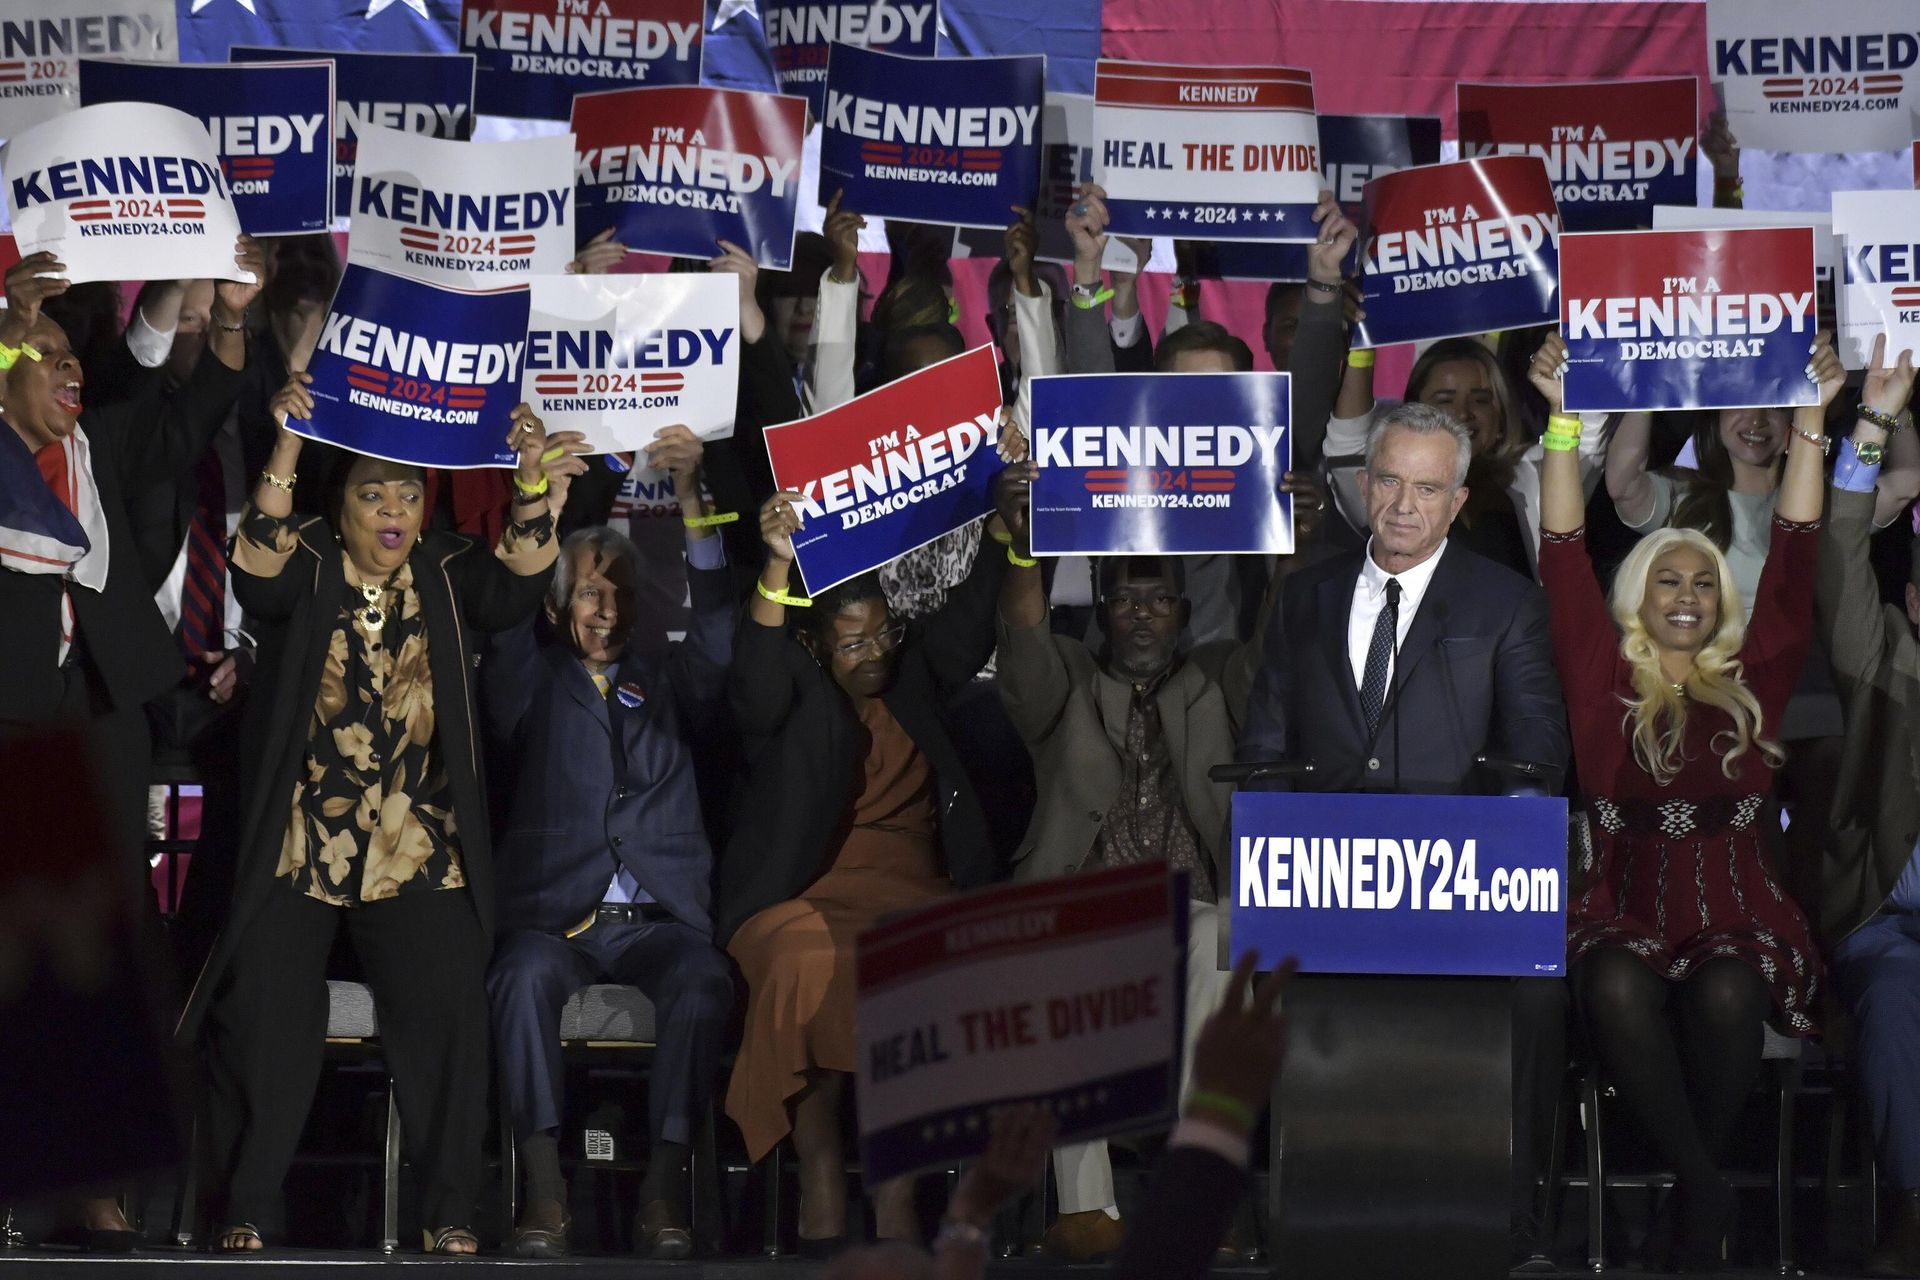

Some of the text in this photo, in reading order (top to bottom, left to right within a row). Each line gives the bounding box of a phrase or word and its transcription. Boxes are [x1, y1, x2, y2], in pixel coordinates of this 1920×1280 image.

[594, 0, 611, 16] A
[0, 14, 164, 58] NNEDY
[465, 8, 700, 61] KENNEDY
[511, 54, 649, 80] DEMOCRAT
[1716, 32, 1920, 75] KENNED
[31, 60, 79, 79] 202
[1179, 86, 1259, 103] KENNEDY
[1808, 78, 1860, 96] 2024
[826, 89, 1039, 147] KENNEDY
[1770, 98, 1899, 114] KENNEDY24.COM
[652, 127, 706, 145] I'M A
[1552, 125, 1607, 142] I'M A
[907, 147, 960, 167] 2024
[1103, 140, 1173, 170] HEAL
[1182, 143, 1234, 171] THE
[1243, 144, 1318, 172] DIVIDE
[1465, 136, 1694, 181] NNEDY
[12, 156, 226, 210] KENNEDY
[575, 145, 797, 197] KENNEDY
[864, 164, 998, 186] KENNEDY24.COM
[115, 199, 165, 218] 2024
[359, 177, 570, 232] KENNEDY
[606, 185, 743, 213] DEMOCRAT
[1194, 207, 1237, 224] 2024
[1424, 204, 1480, 226] I'M A
[80, 222, 205, 237] KENNEDY24.COM
[444, 235, 496, 255] 2024
[405, 250, 531, 272] KENNEDY24.COM
[1842, 244, 1920, 285] KE
[1393, 258, 1529, 294] DEMOCRAT
[1663, 277, 1721, 294] I'M A
[1568, 292, 1813, 340] KENNEDY
[317, 311, 525, 385] KENNEDY
[1620, 338, 1765, 361] DEMOCRAT
[391, 376, 446, 404] 2024
[583, 373, 637, 393] 2024
[349, 388, 479, 425] KENNEDY24.COM
[543, 395, 679, 411] KENNEDY24.COM
[868, 424, 922, 457] I'M A
[1036, 425, 1286, 468] KENNEDY
[785, 405, 1003, 523] KENNEDY
[1135, 470, 1188, 490] 2024
[840, 465, 968, 530] DEMOCRAT
[1092, 494, 1231, 508] KENNEDY24.COM
[1239, 836, 1559, 912] KENNEDY24.com
[869, 973, 1161, 1085] HEAL THE DIVIDE
